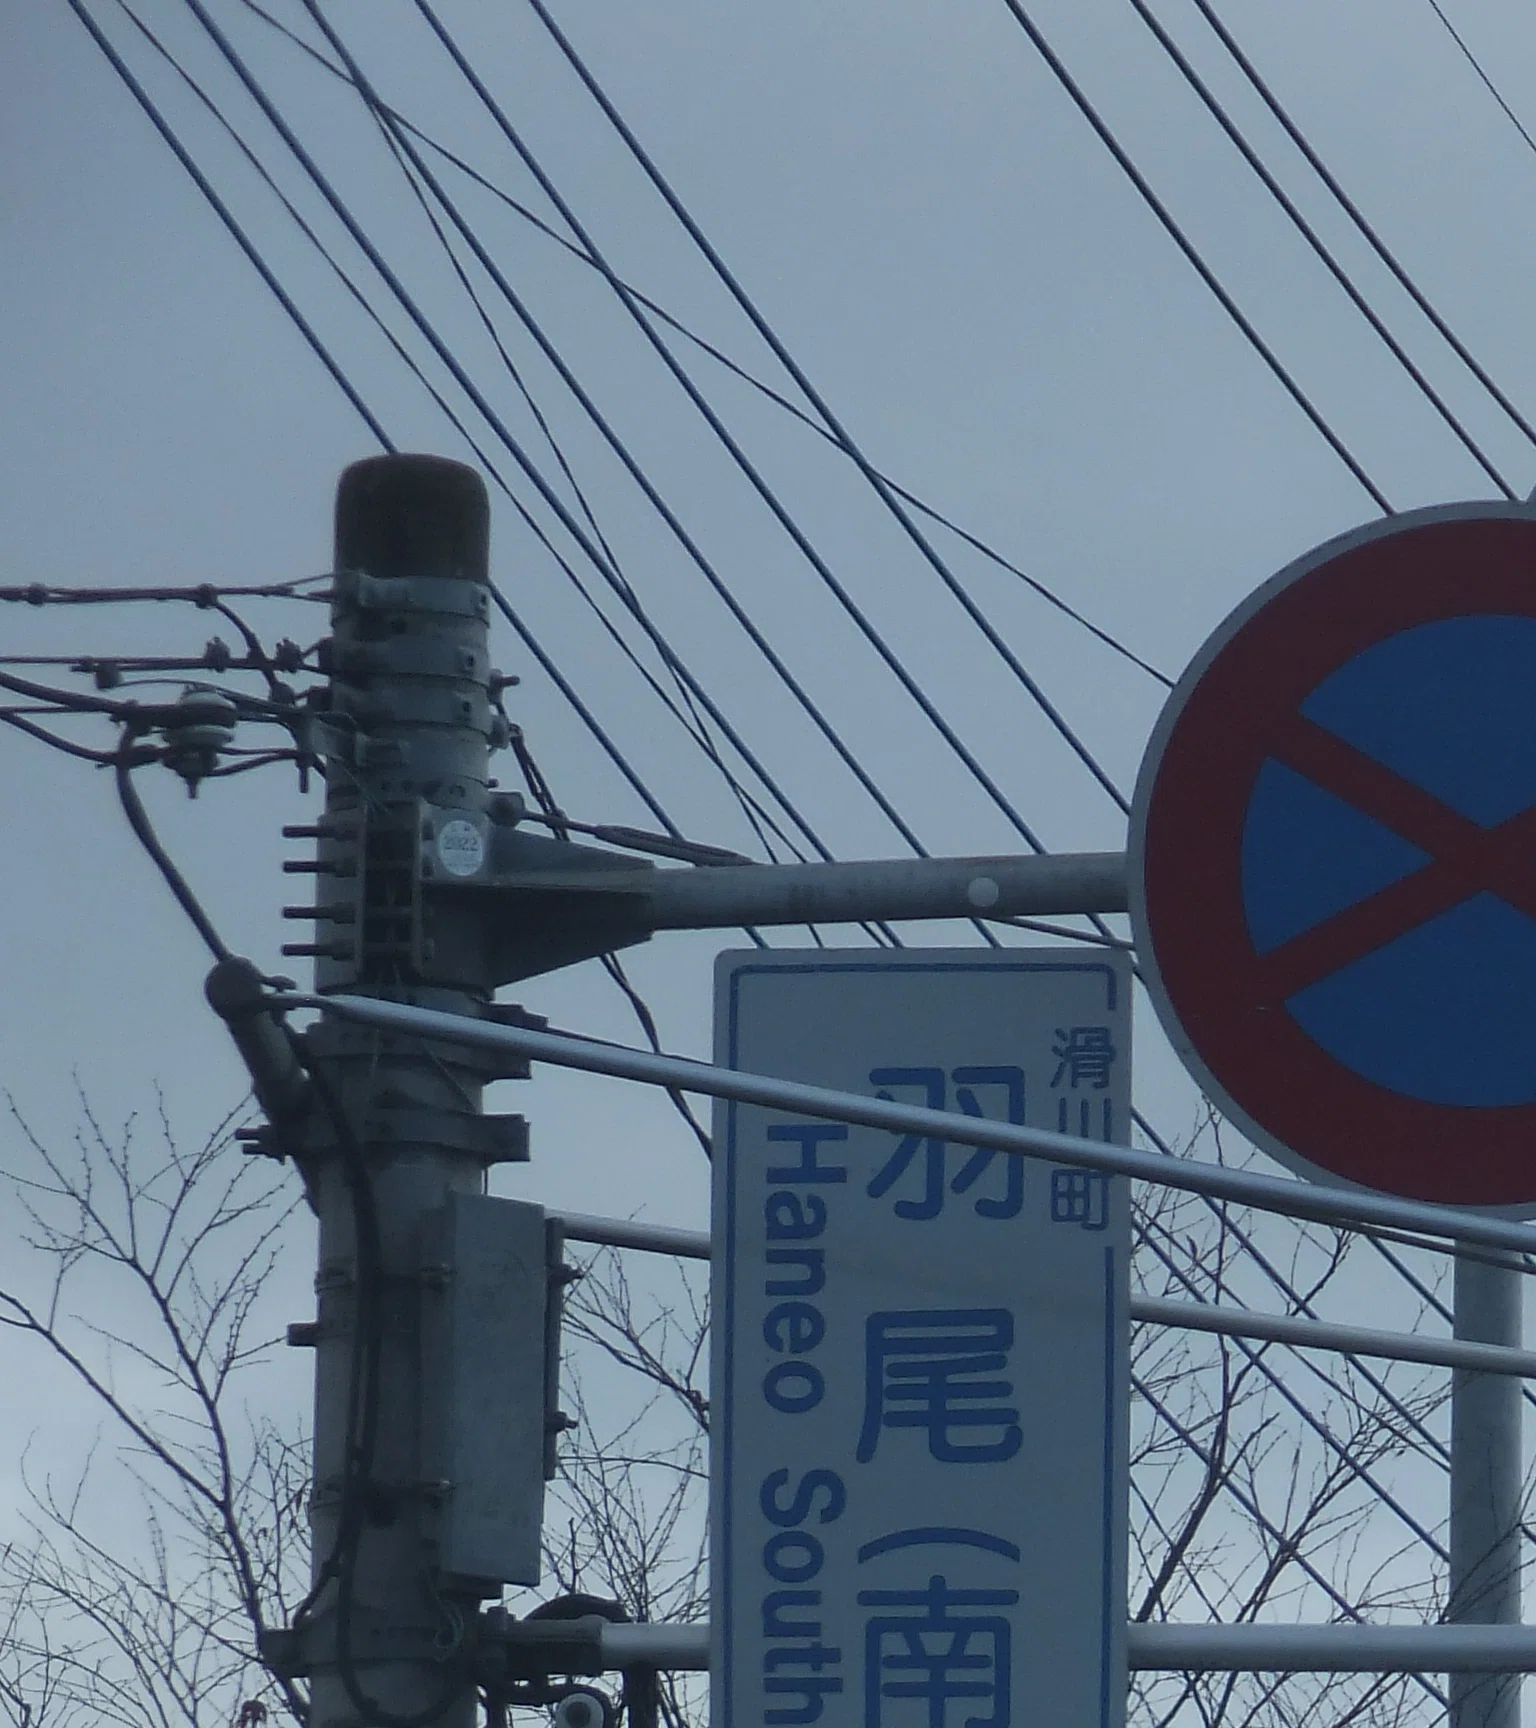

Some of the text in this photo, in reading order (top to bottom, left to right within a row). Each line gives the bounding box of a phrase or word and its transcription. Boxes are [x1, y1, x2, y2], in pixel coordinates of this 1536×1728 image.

[1050, 1027, 1117, 1231] 滑川町
[759, 1124, 849, 1727] Haneo South
